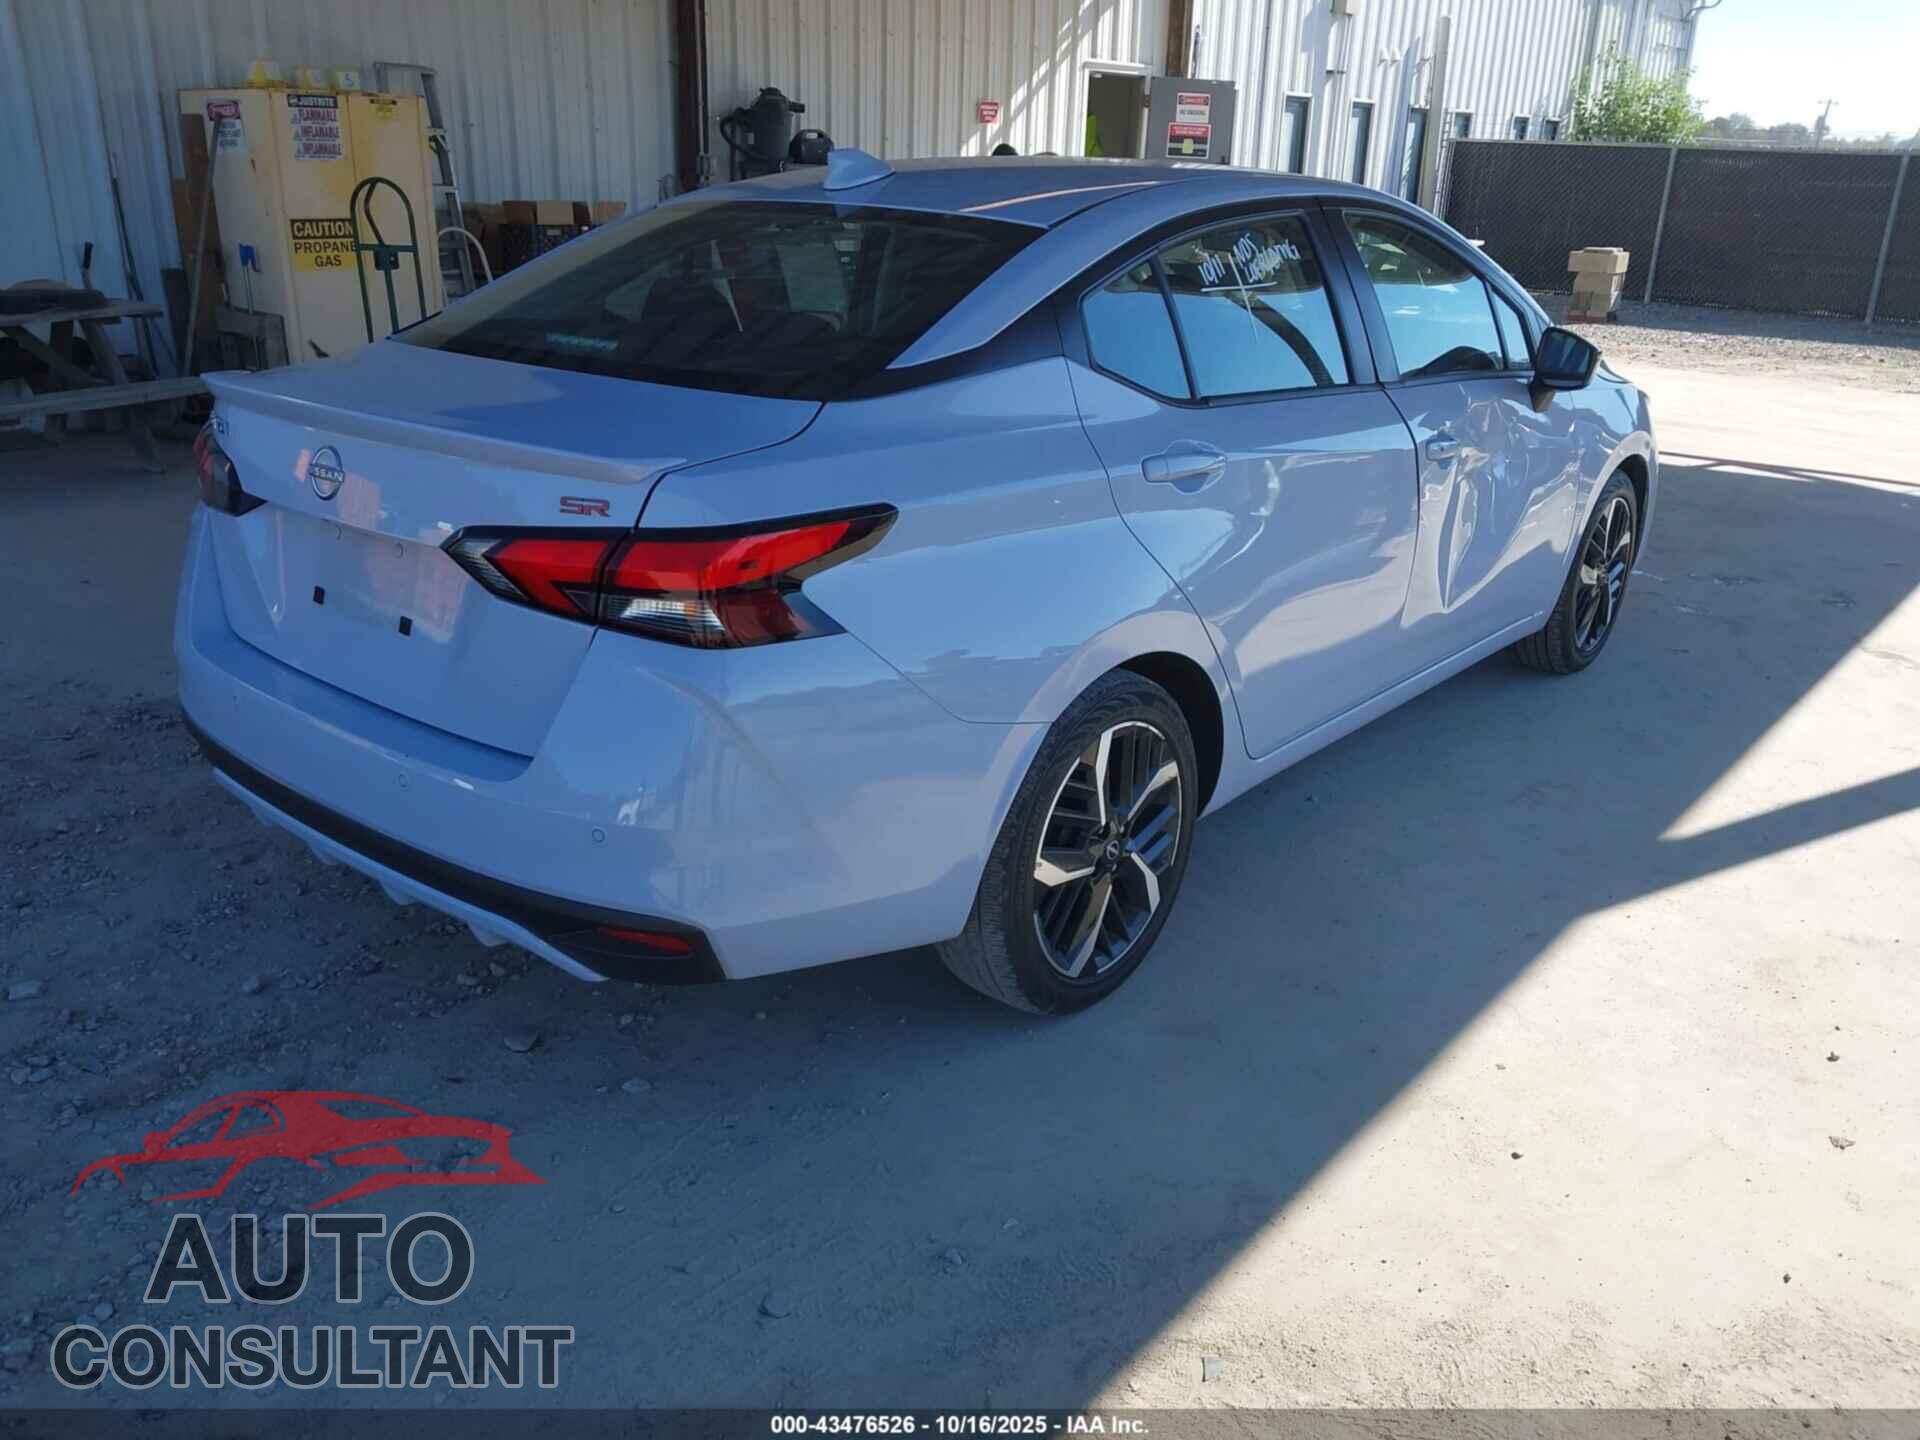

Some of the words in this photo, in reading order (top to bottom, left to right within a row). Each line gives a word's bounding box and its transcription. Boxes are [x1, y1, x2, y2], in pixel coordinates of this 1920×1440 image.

[293, 221, 354, 237] CAUTION
[295, 240, 357, 254] PROPANE
[315, 255, 342, 267] GAS
[560, 496, 611, 517] SR
